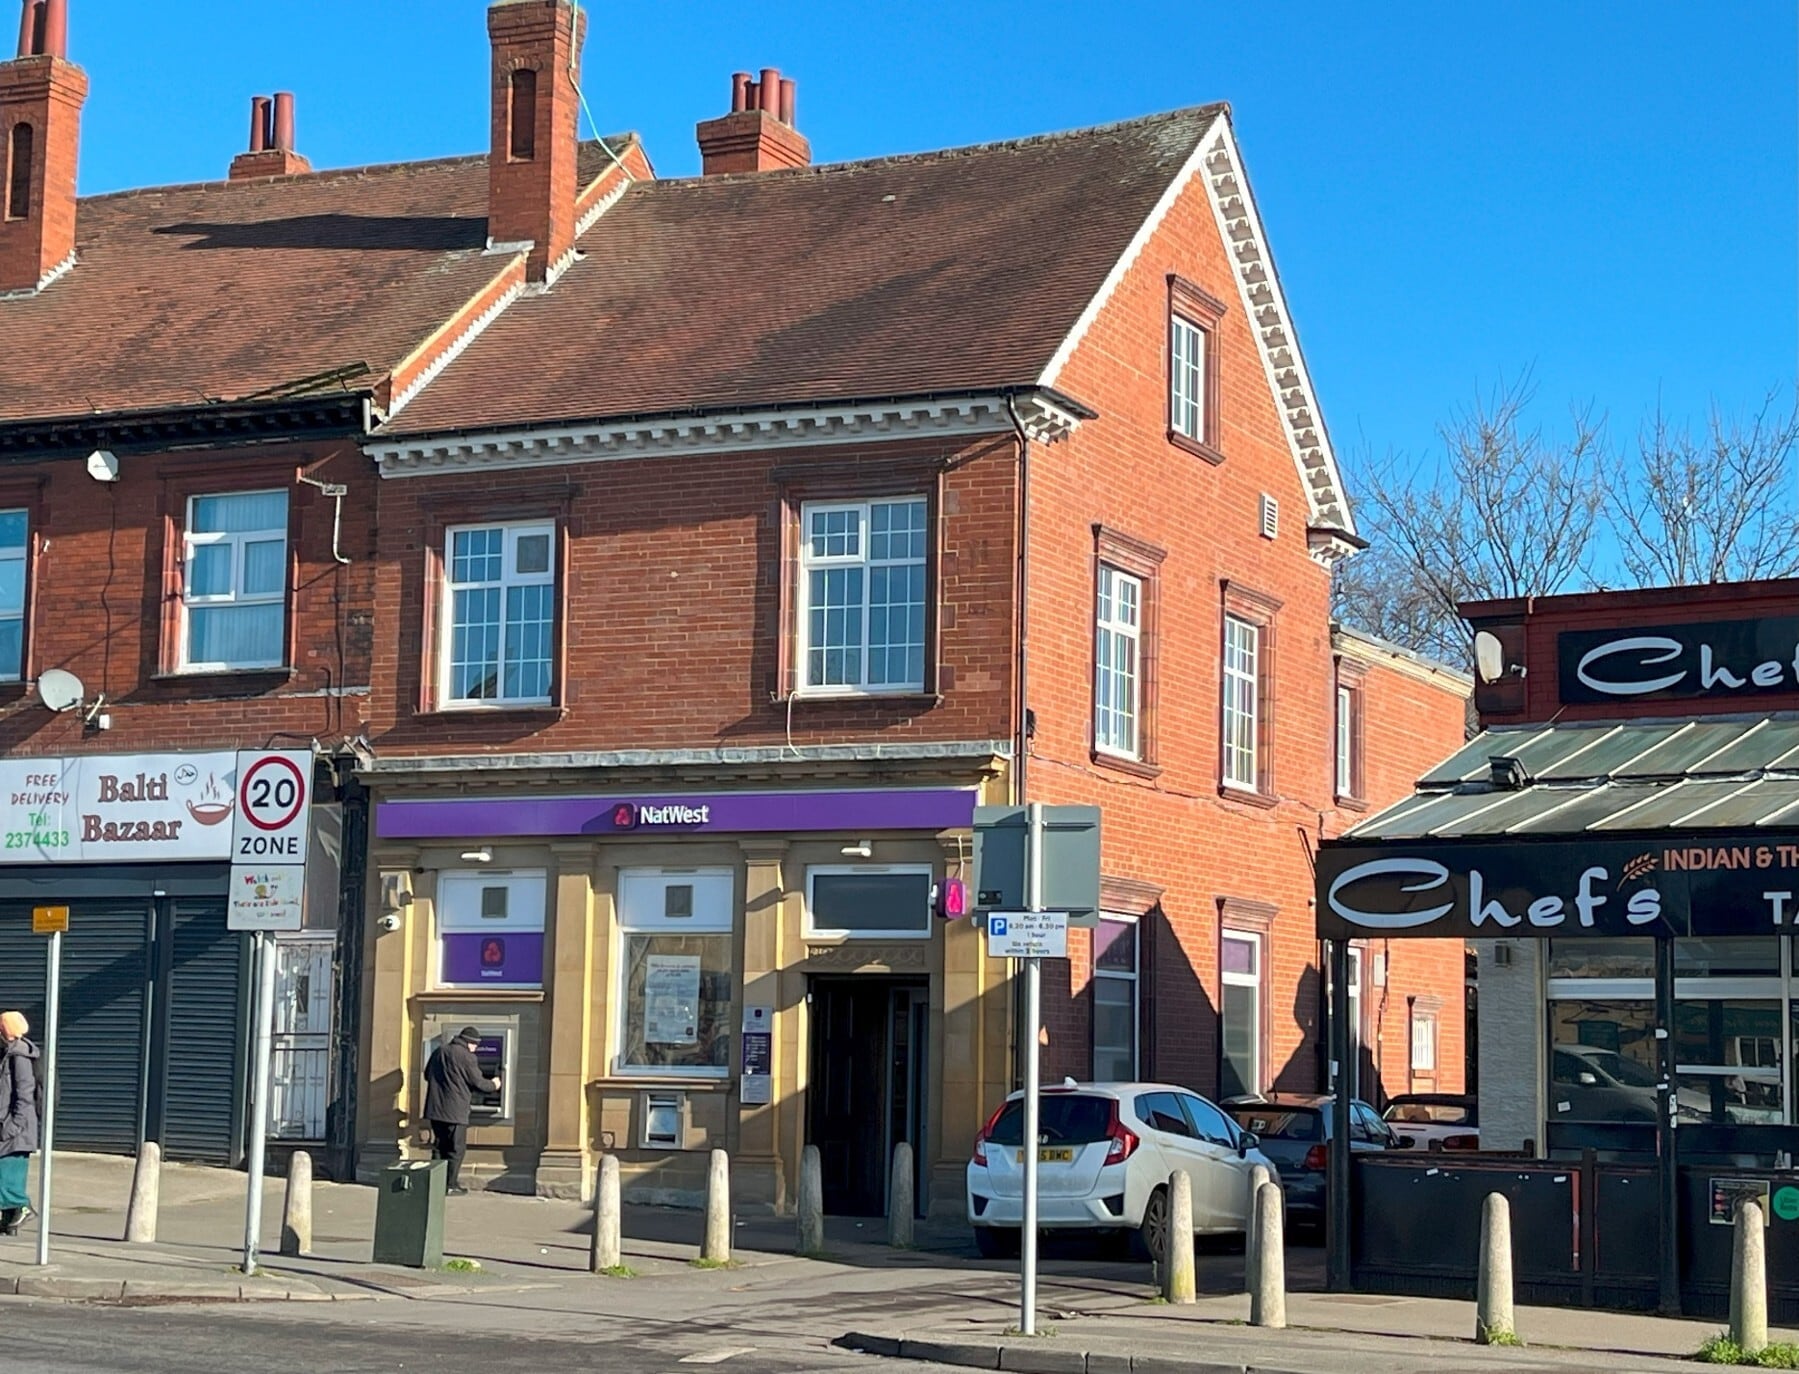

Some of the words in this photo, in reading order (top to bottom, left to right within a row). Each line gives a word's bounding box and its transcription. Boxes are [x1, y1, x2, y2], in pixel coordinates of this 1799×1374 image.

[1577, 636, 1799, 694] Che
[26, 774, 57, 787] FREE
[98, 772, 169, 803] Balti
[11, 792, 69, 806] DELIVERY
[252, 778, 296, 808] 20
[28, 813, 51, 826] Tel:
[640, 805, 709, 825] NatWest
[81, 814, 182, 842] Bazaar
[5, 831, 70, 848] 2374433
[240, 836, 299, 855] ZONE
[1663, 846, 1751, 871] INDIAN
[1756, 846, 1773, 868] &
